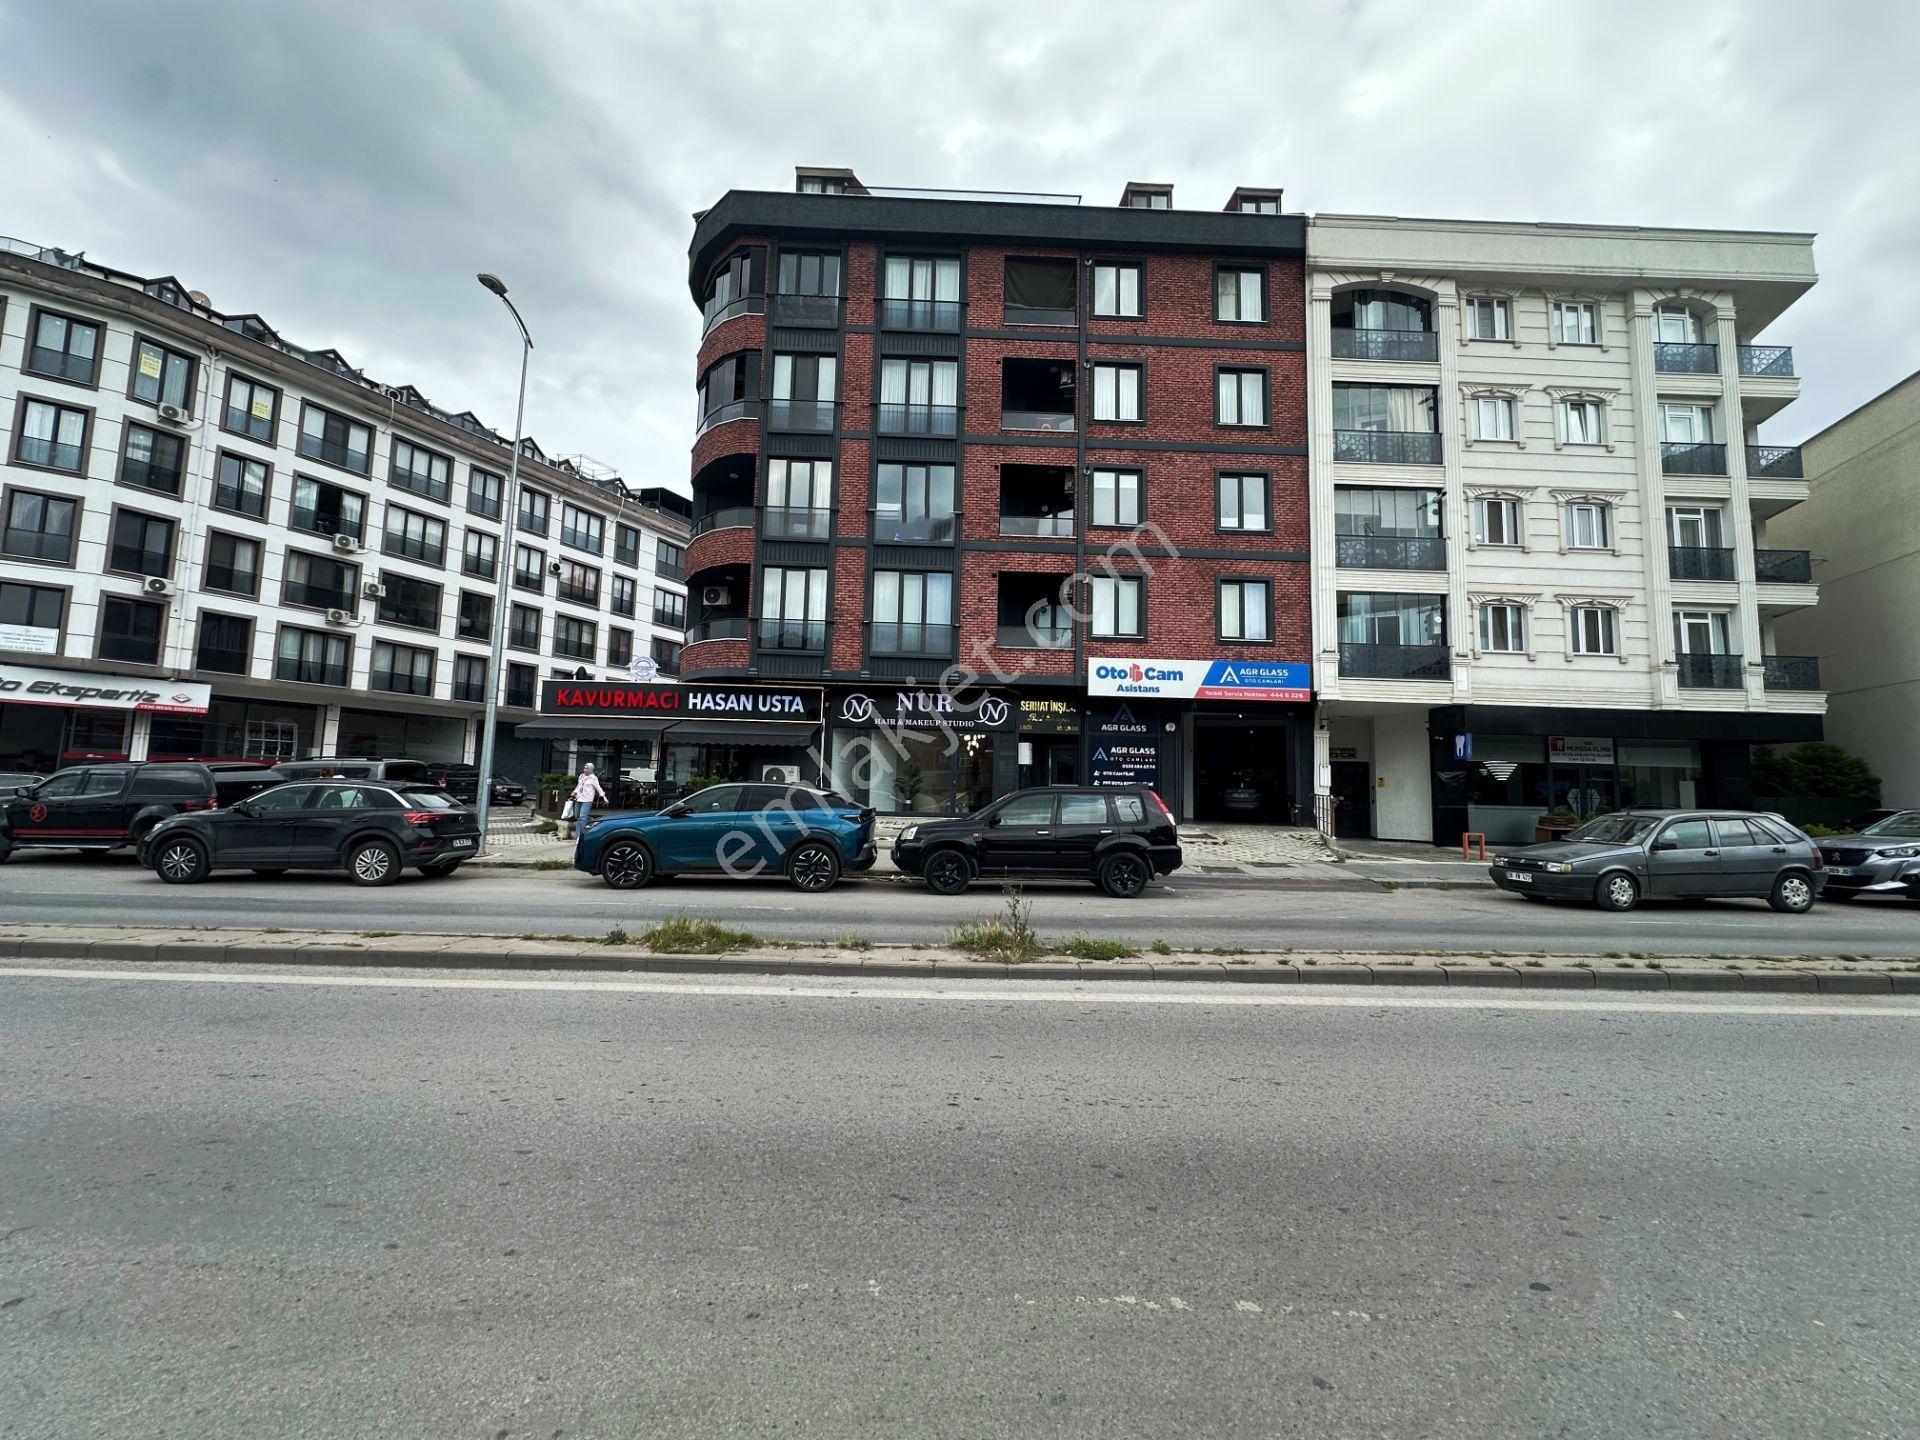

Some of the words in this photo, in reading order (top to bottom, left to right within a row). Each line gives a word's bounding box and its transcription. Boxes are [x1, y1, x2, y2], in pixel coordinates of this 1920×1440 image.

[1095, 665, 1129, 680] Oto
[1144, 667, 1184, 681] Cam
[1240, 668, 1258, 676] AGR
[1259, 668, 1289, 677] GLASS
[26, 680, 161, 703] Ekspertiz
[1116, 684, 1160, 693] Asistans
[556, 688, 679, 709] KAVURMACI
[688, 692, 753, 711] HASAN
[758, 695, 805, 713] USTA
[896, 692, 954, 712] NUR
[874, 718, 896, 726] HAIR
[897, 718, 904, 726] &
[905, 719, 941, 727] MAKEUP
[942, 719, 975, 728] STUDIO
[1101, 724, 1119, 732] AGR
[1120, 724, 1147, 732] GLASS
[1110, 746, 1128, 754] AGR
[1128, 746, 1156, 755] GLASS
